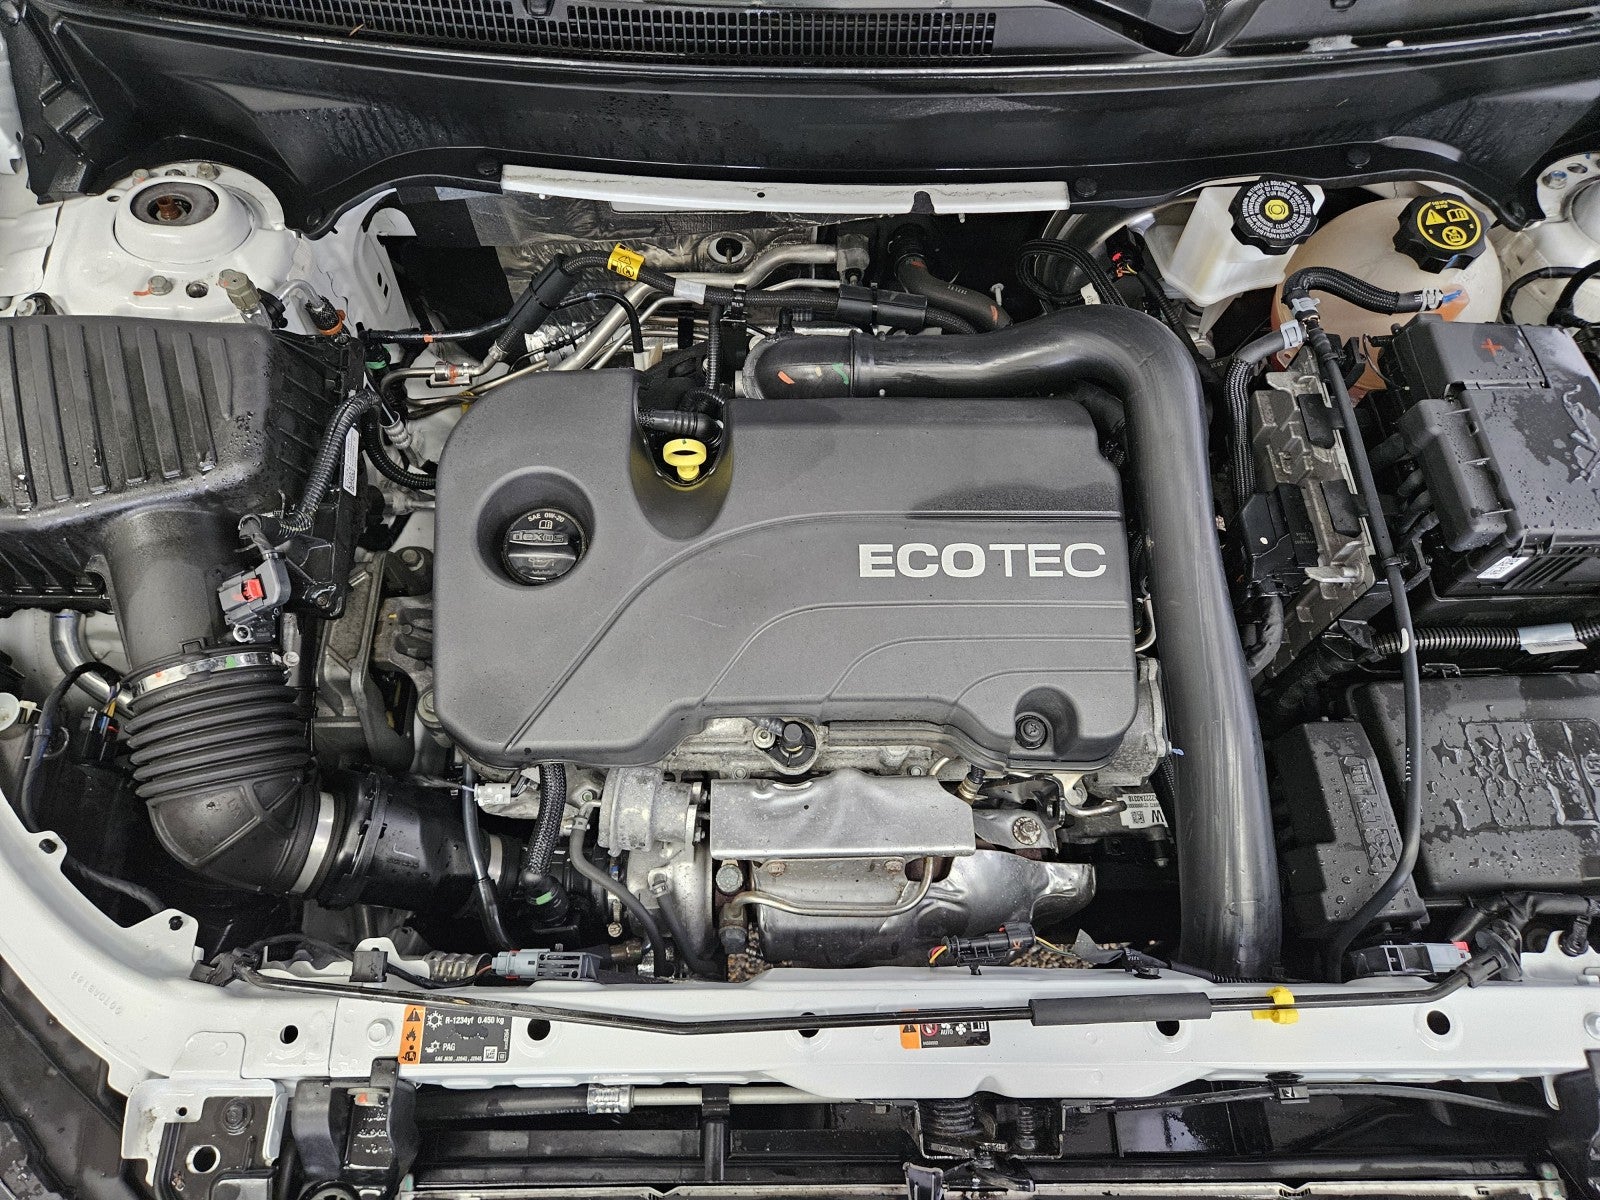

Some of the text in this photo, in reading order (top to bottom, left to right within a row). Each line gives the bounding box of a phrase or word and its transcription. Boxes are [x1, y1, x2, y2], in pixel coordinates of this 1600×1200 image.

[527, 512, 565, 522] SAE 0W-20
[512, 530, 564, 543] dexos
[858, 542, 1107, 578] ECOTEC
[445, 1016, 505, 1025] R-1234yf 0.450 kg
[442, 1042, 456, 1051] PAG
